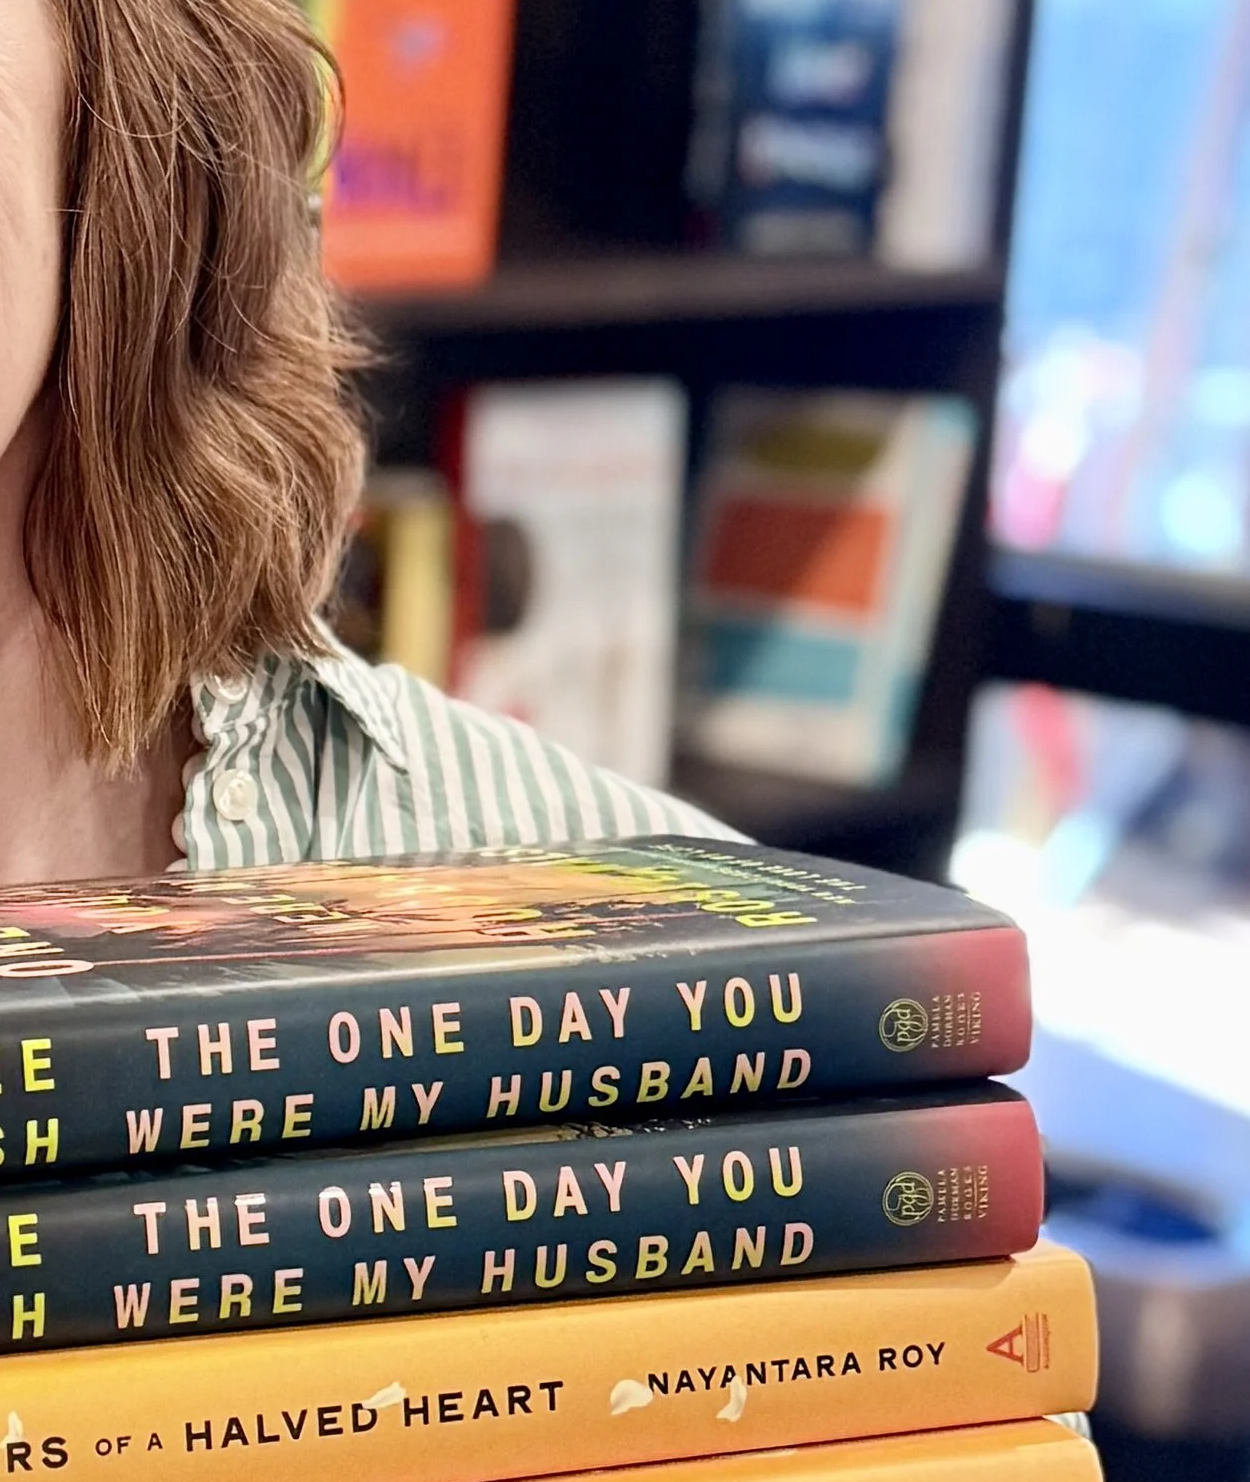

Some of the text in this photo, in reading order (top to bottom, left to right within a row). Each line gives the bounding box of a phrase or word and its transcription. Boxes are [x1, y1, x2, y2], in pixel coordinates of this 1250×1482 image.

[146, 973, 804, 1080] THE ONE DAY YOU
[125, 1048, 812, 1155] WERE MY HUSBAND
[133, 1146, 804, 1256] THE ONE DAY YOU
[113, 1222, 815, 1329] WERE MY HUSBAND
[95, 1434, 132, 1458] OF
[147, 1432, 164, 1452] A
[184, 1402, 378, 1452] HALVED
[403, 1380, 565, 1428] HEART
[647, 1341, 947, 1397] NAYANTARA ROY
